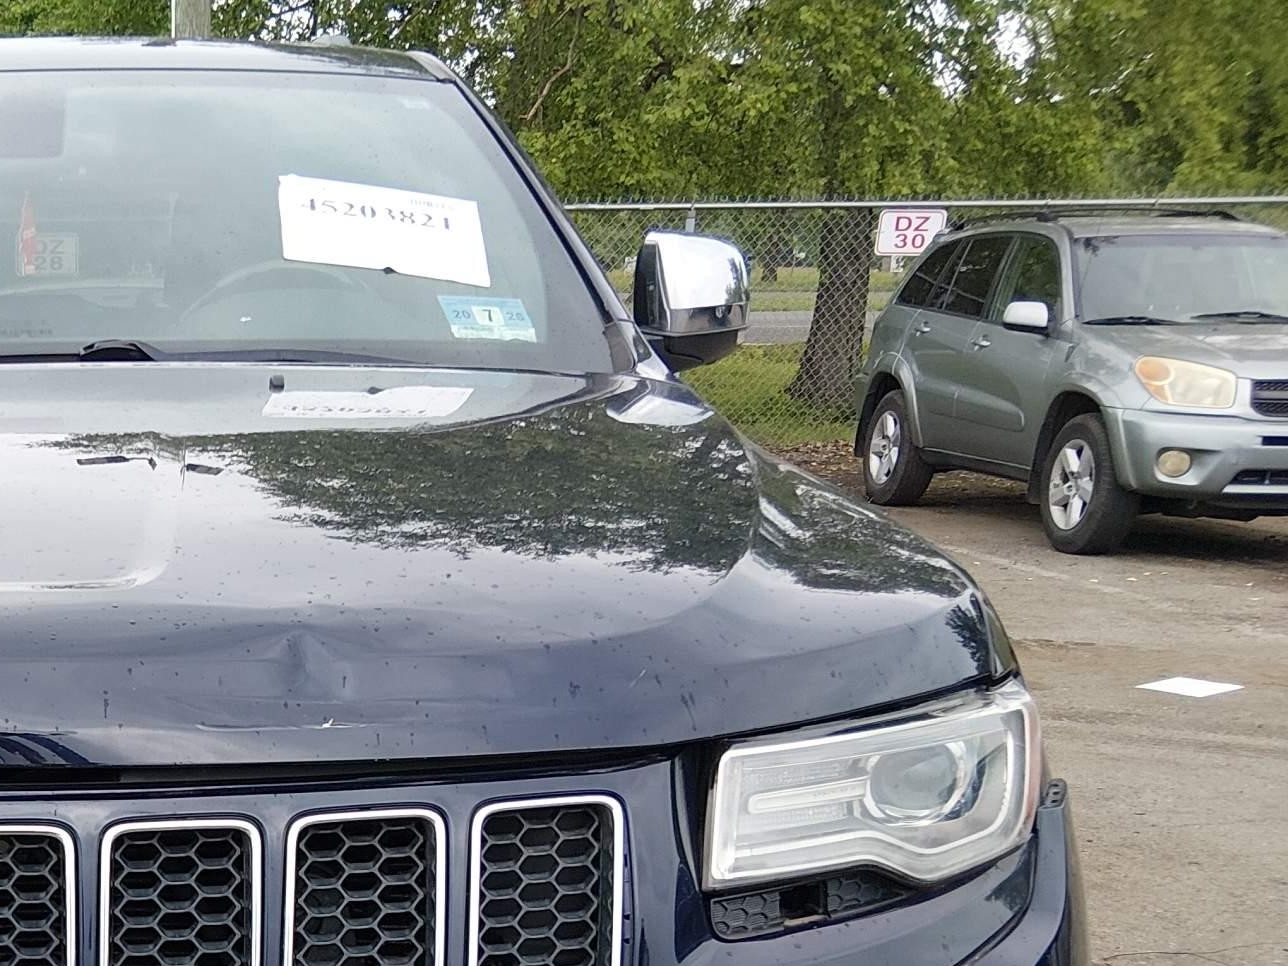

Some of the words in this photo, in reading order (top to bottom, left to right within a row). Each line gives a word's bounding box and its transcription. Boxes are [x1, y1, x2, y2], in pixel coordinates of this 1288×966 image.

[895, 216, 931, 232] DZ
[894, 233, 925, 249] 30
[34, 256, 64, 271] 28
[481, 309, 493, 322] 7
